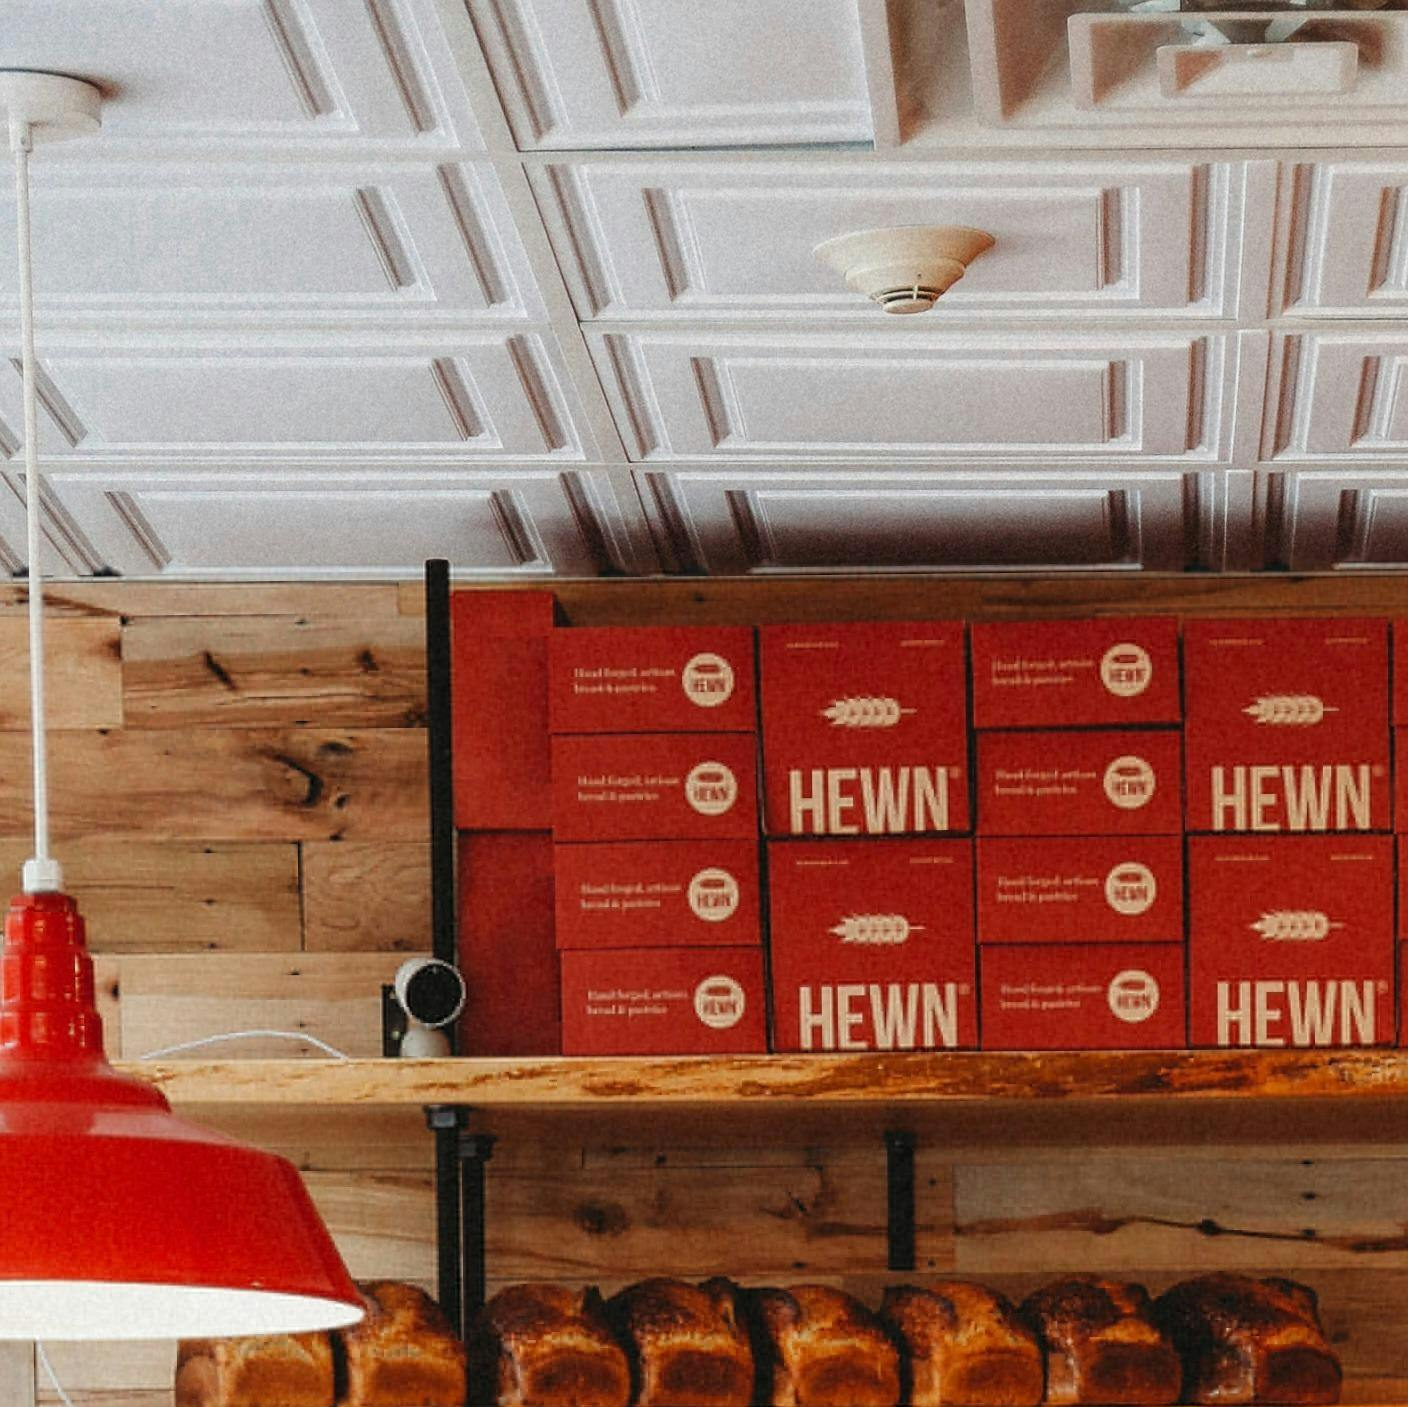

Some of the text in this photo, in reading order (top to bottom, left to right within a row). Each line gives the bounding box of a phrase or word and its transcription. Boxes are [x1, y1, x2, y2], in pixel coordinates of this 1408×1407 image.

[790, 767, 948, 833] HEWN
[1212, 765, 1370, 830] HEWN
[800, 983, 957, 1049] HEWN
[1218, 981, 1374, 1045] HEWN
